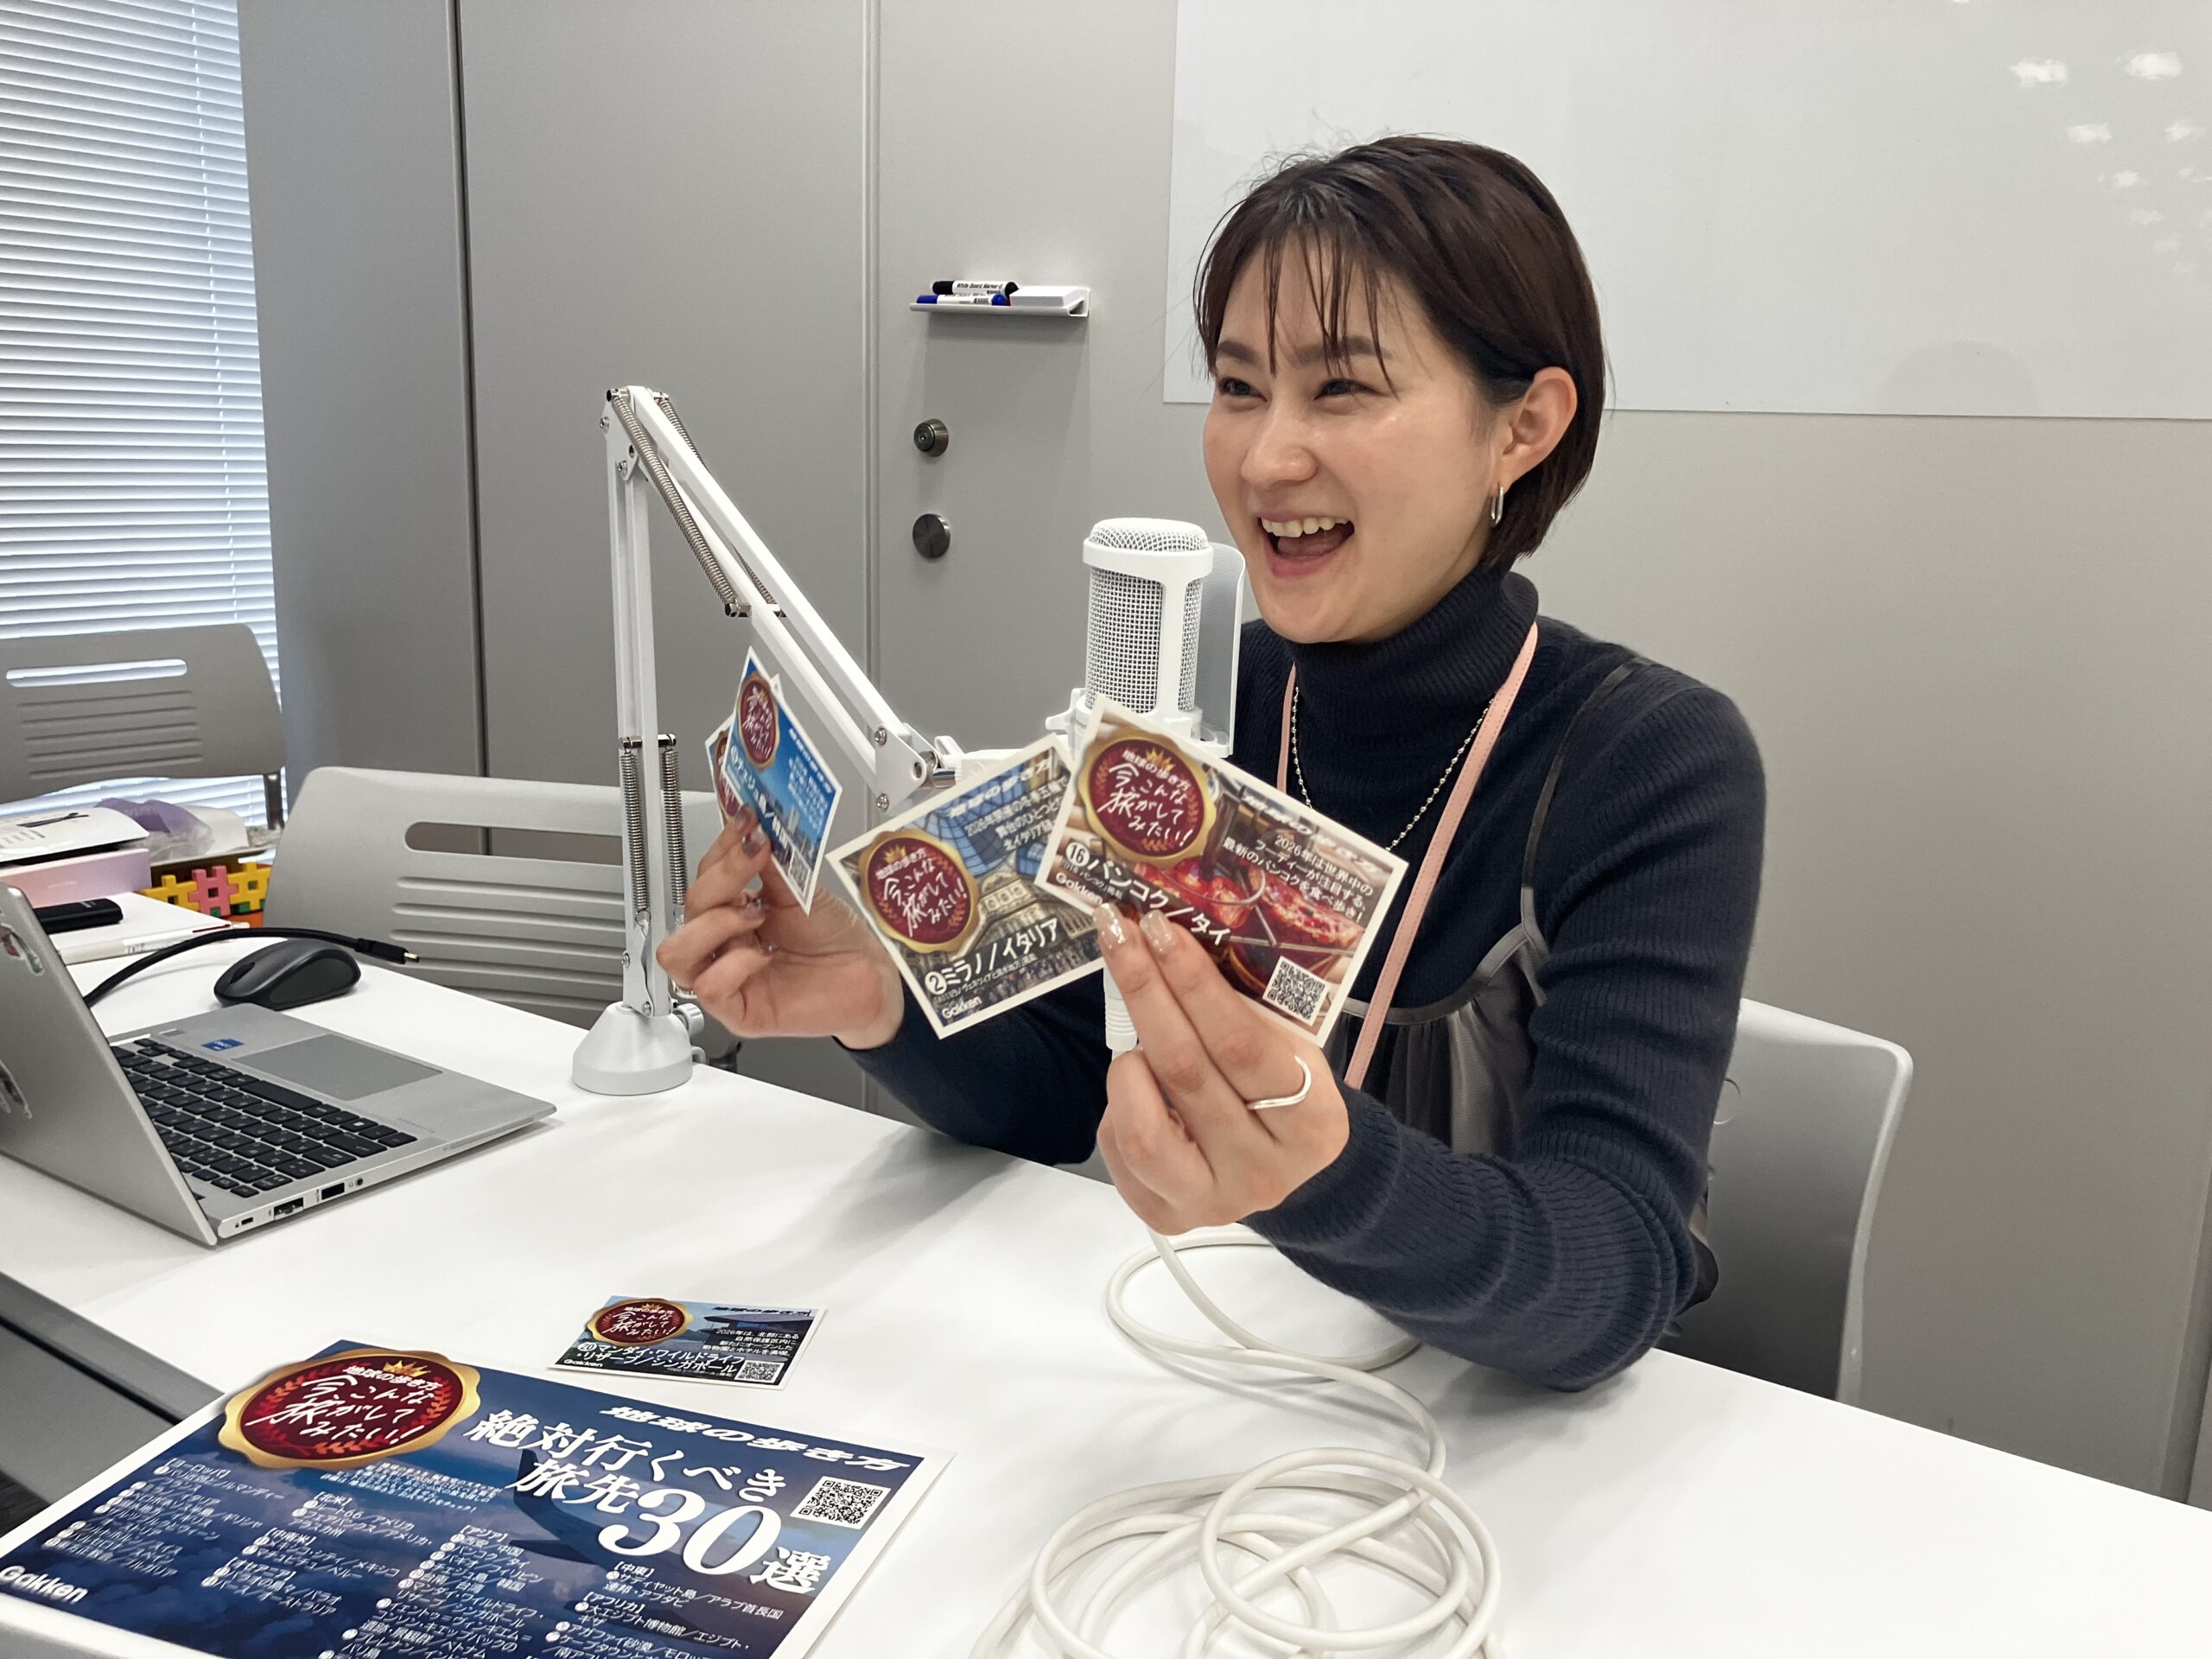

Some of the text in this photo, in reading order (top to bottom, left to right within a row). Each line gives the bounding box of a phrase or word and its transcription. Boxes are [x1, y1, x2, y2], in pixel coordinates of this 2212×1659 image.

[1274, 834, 1375, 897] 2026年は世界中の
[1054, 869, 1105, 907] Gakken
[939, 992, 983, 1020] Gakken
[343, 1364, 442, 1392] 地球の歩き方
[561, 1358, 605, 1367] Gakken
[463, 1408, 786, 1503] 絶対行くべき
[599, 1405, 914, 1471] 地球の歩き方
[0, 1565, 89, 1605] Gakken
